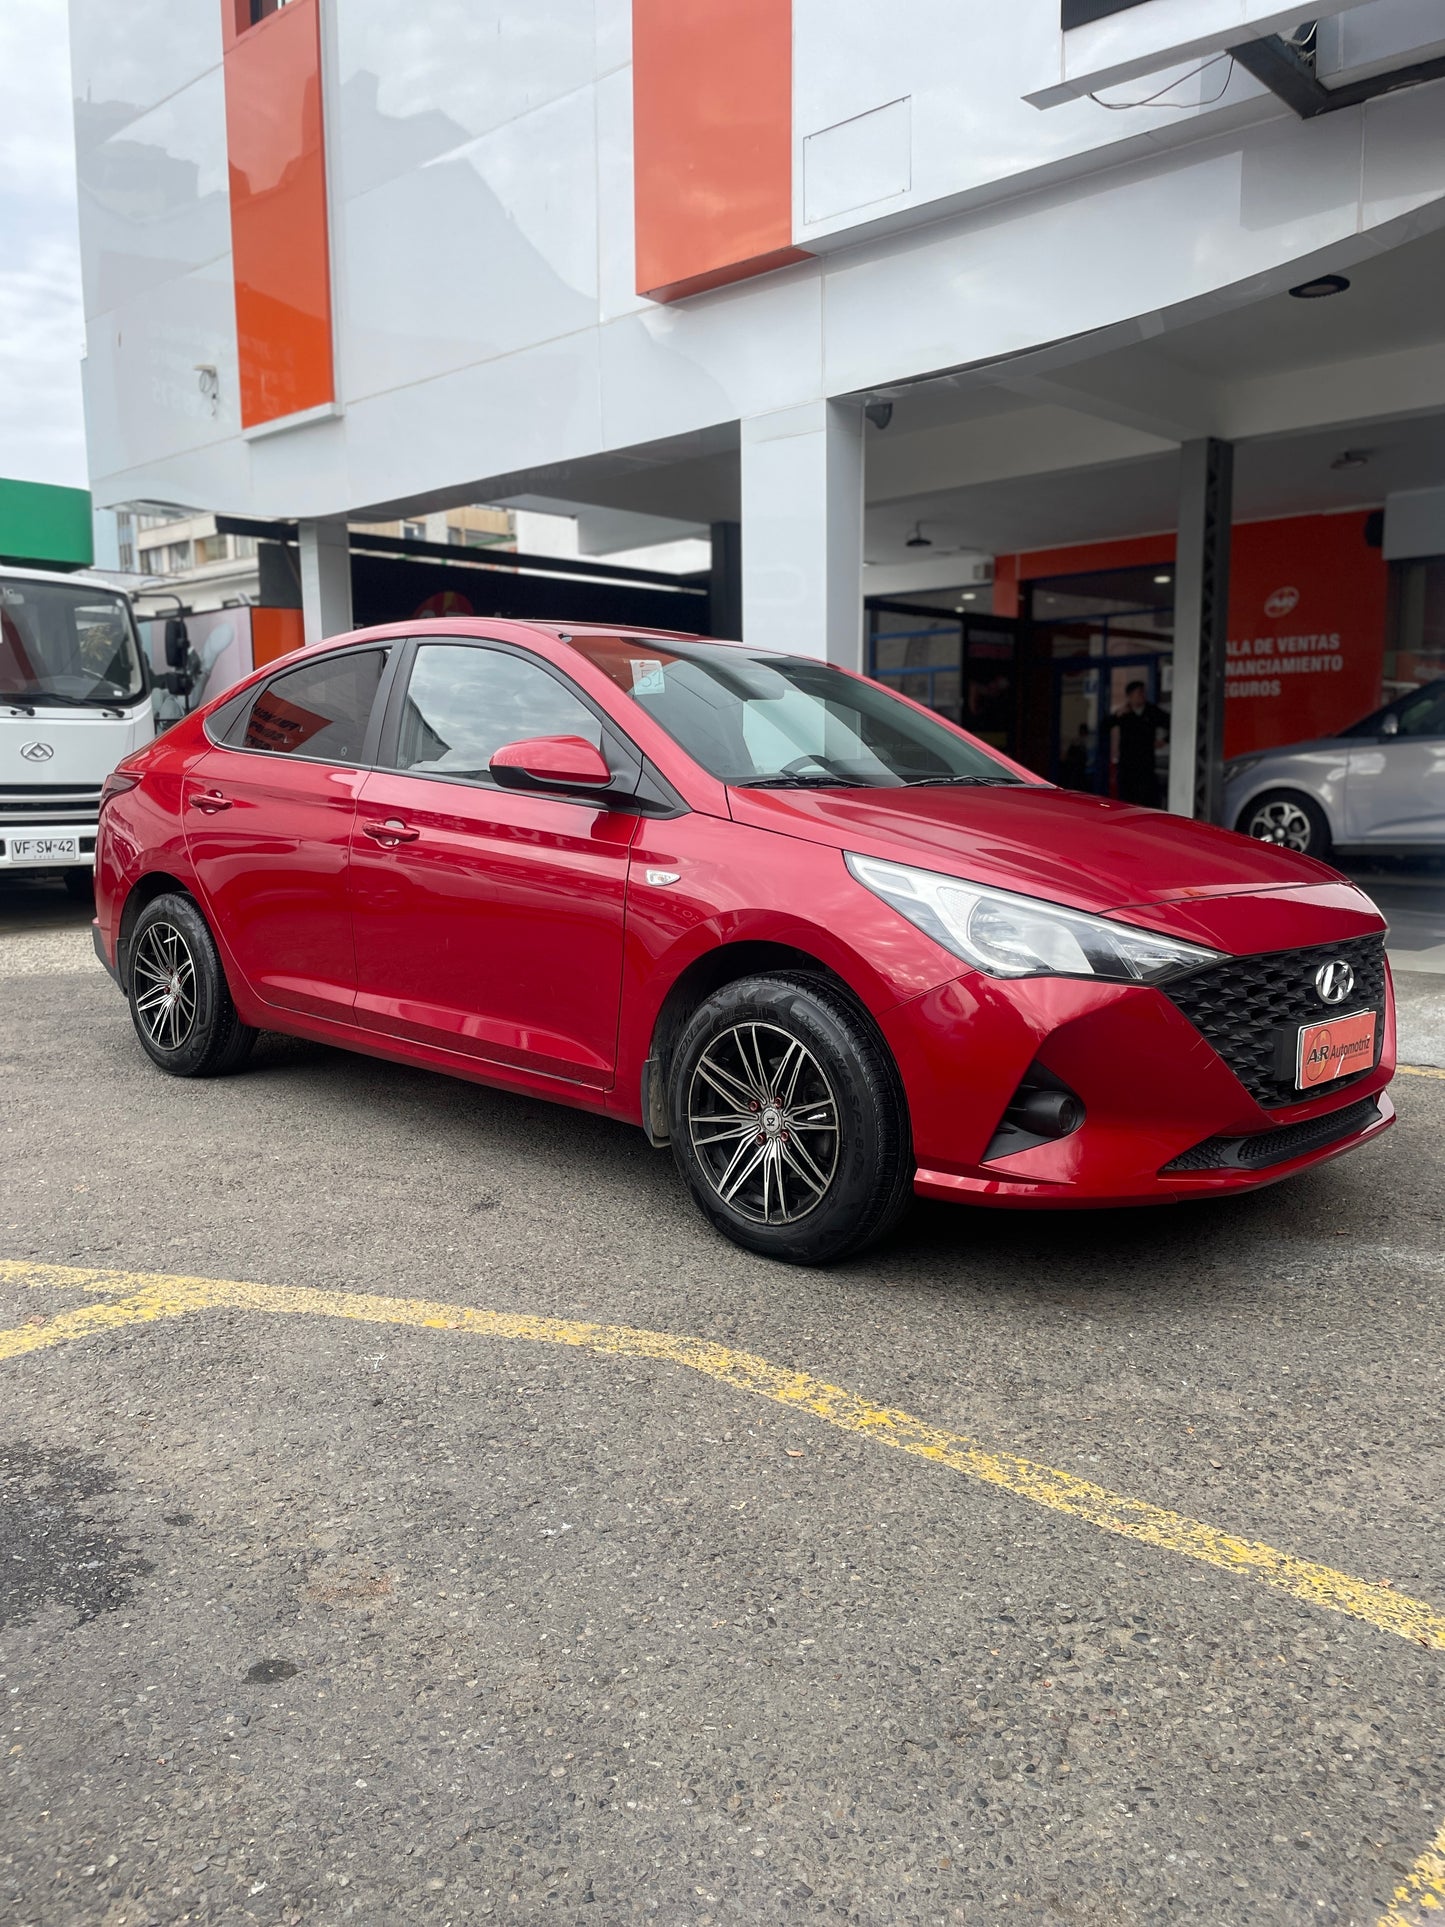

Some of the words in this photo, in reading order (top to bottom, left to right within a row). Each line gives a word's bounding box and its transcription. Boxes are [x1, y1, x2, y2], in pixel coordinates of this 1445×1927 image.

[1225, 638, 1252, 656] ALA
[1254, 637, 1274, 656] DE
[1276, 632, 1341, 653] VENTAS
[1224, 654, 1344, 677] NANCIAMIENTO
[1329, 1035, 1370, 1060] Automotriz
